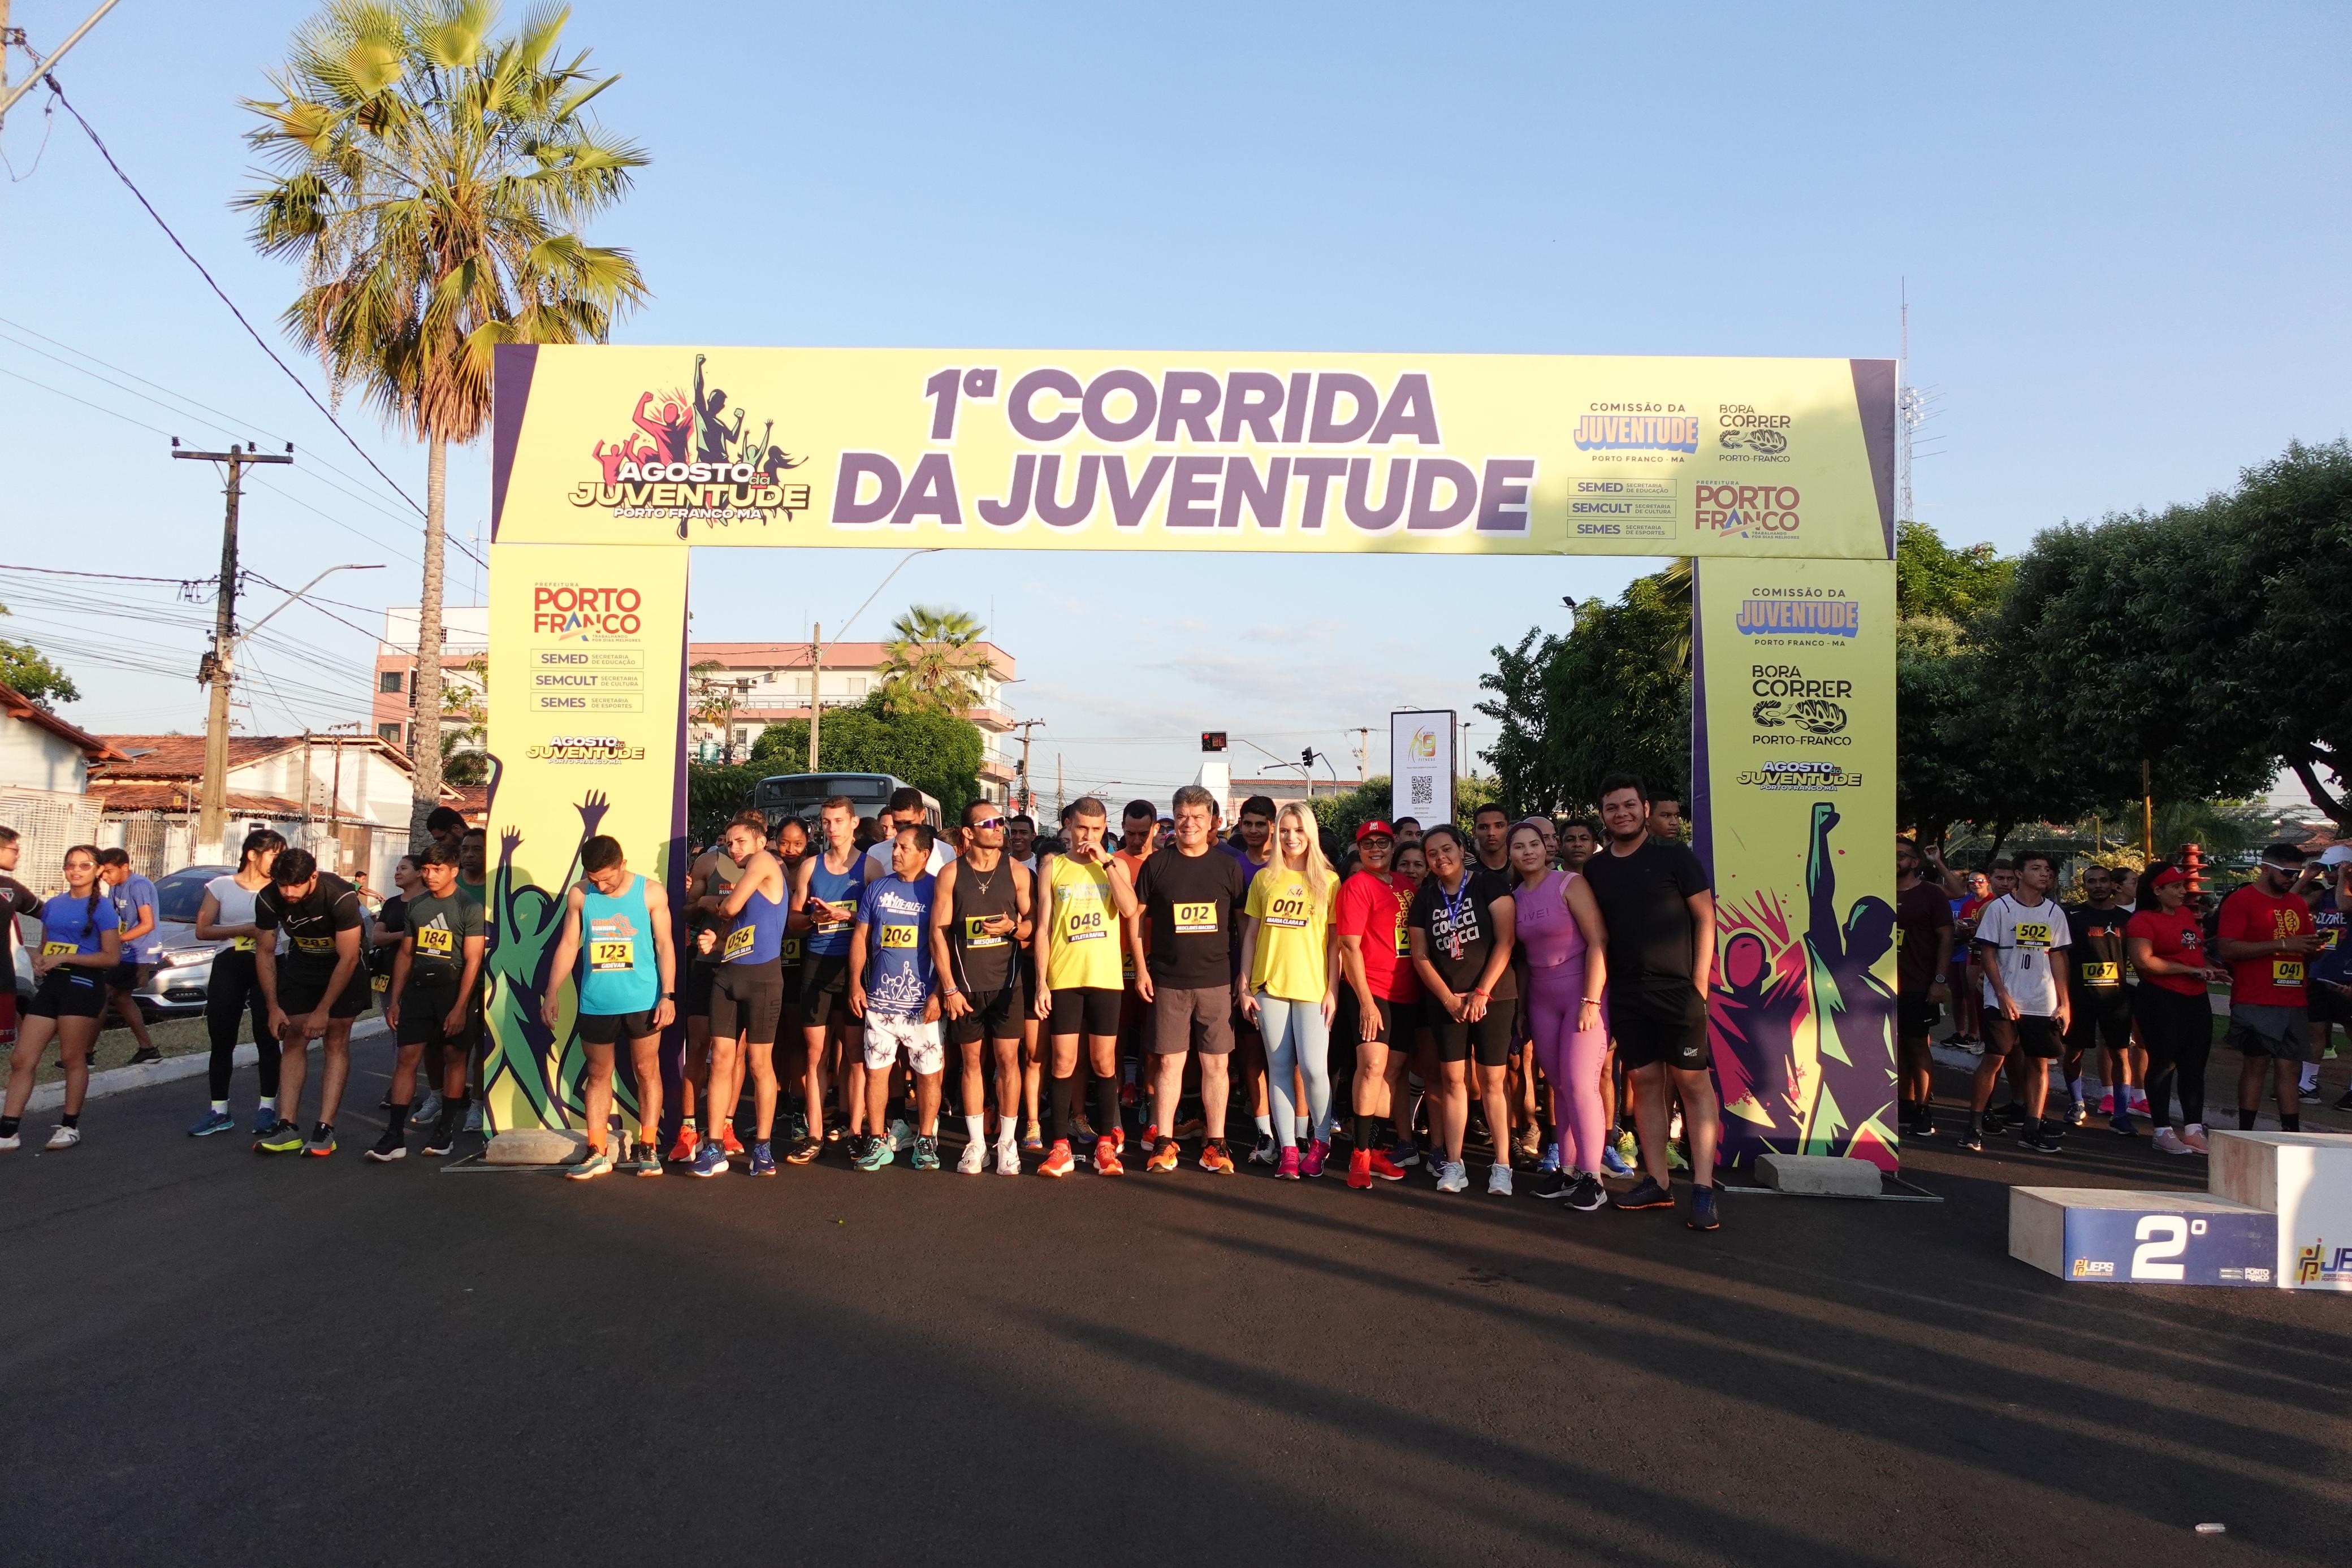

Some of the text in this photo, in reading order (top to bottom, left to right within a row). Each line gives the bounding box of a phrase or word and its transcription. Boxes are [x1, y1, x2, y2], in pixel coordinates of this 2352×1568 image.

[1008, 368, 1441, 445] CORRIDA
[1590, 402, 1686, 413] COMISSÃO DA
[1719, 404, 1755, 414] BORA
[1719, 414, 1791, 428] CORRER
[1574, 415, 1698, 447] JUVENTUDE
[616, 462, 771, 486] AGOSTO da
[831, 452, 1536, 531] DA JUVENTUDE
[1577, 482, 1624, 493] SEMED
[568, 482, 810, 510] JUVENTUDE
[1696, 485, 1800, 511] PORTO
[613, 507, 668, 518] PORTO
[1572, 503, 1633, 514] SEMCULT
[1695, 509, 1800, 532] FRANCO
[1577, 523, 1621, 535] SEMES
[534, 587, 641, 612] PORTO
[1752, 587, 1846, 598] COMISSÃO DA
[1737, 600, 1859, 631] JUVENTUDE
[534, 612, 641, 636] FRANCO
[541, 653, 589, 664] SEMED
[1752, 665, 1802, 678] BORA
[535, 675, 598, 686] SEMCULT
[1752, 679, 1852, 698] CORRER
[541, 697, 586, 708] SEMES
[549, 735, 618, 747] AGOSTO
[525, 746, 645, 760] JUVENTUDE
[1761, 761, 1834, 773] AGOSTO
[1736, 771, 1862, 787] JUVENTUDE
[1181, 906, 1209, 920] 012
[1273, 899, 1304, 915] 001
[1432, 898, 1473, 921] COCI
[1070, 912, 1101, 930] 048
[424, 930, 447, 946] 184
[884, 928, 912, 943] 206
[1436, 925, 1480, 951] COCCI
[2020, 925, 2047, 938] 502
[301, 938, 330, 947] 283
[728, 929, 750, 950] 056
[48, 943, 71, 955] 571
[599, 944, 626, 959] 123
[2020, 953, 2031, 970] 10
[2087, 964, 2114, 977] 067
[2279, 963, 2301, 976] 041
[2086, 1261, 2115, 1272] JEPS
